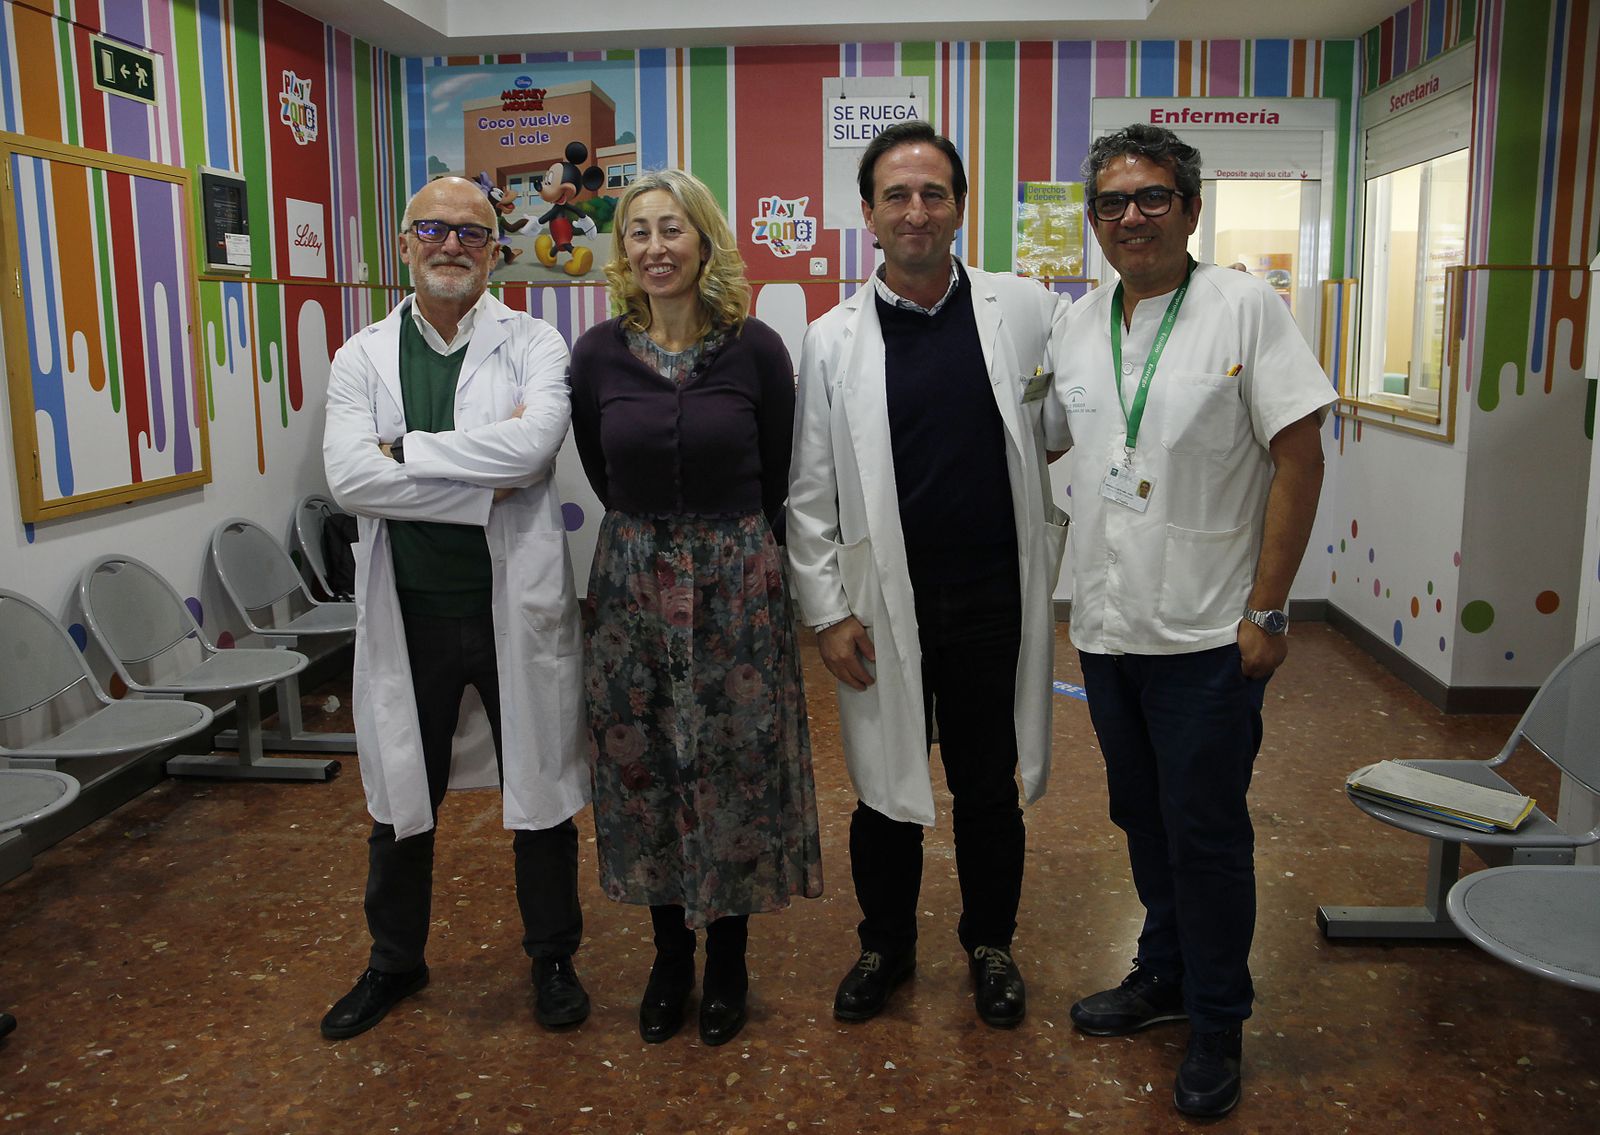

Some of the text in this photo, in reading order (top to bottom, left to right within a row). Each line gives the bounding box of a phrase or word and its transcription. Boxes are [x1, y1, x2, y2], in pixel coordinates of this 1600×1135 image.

[501, 88, 547, 100] MICKEY
[1389, 74, 1440, 112] Secretaría
[502, 100, 544, 111] MOUSE
[833, 105, 918, 120] SE RUEGA
[478, 112, 570, 130] Coco vuelve
[1150, 107, 1280, 125] Enfermería
[500, 130, 550, 146] al cole
[833, 123, 896, 140] SILEN
[1028, 185, 1066, 194] Derechos
[1033, 193, 1067, 201] deberes
[294, 223, 323, 257] Lilly
[1141, 363, 1154, 388] Entrega
